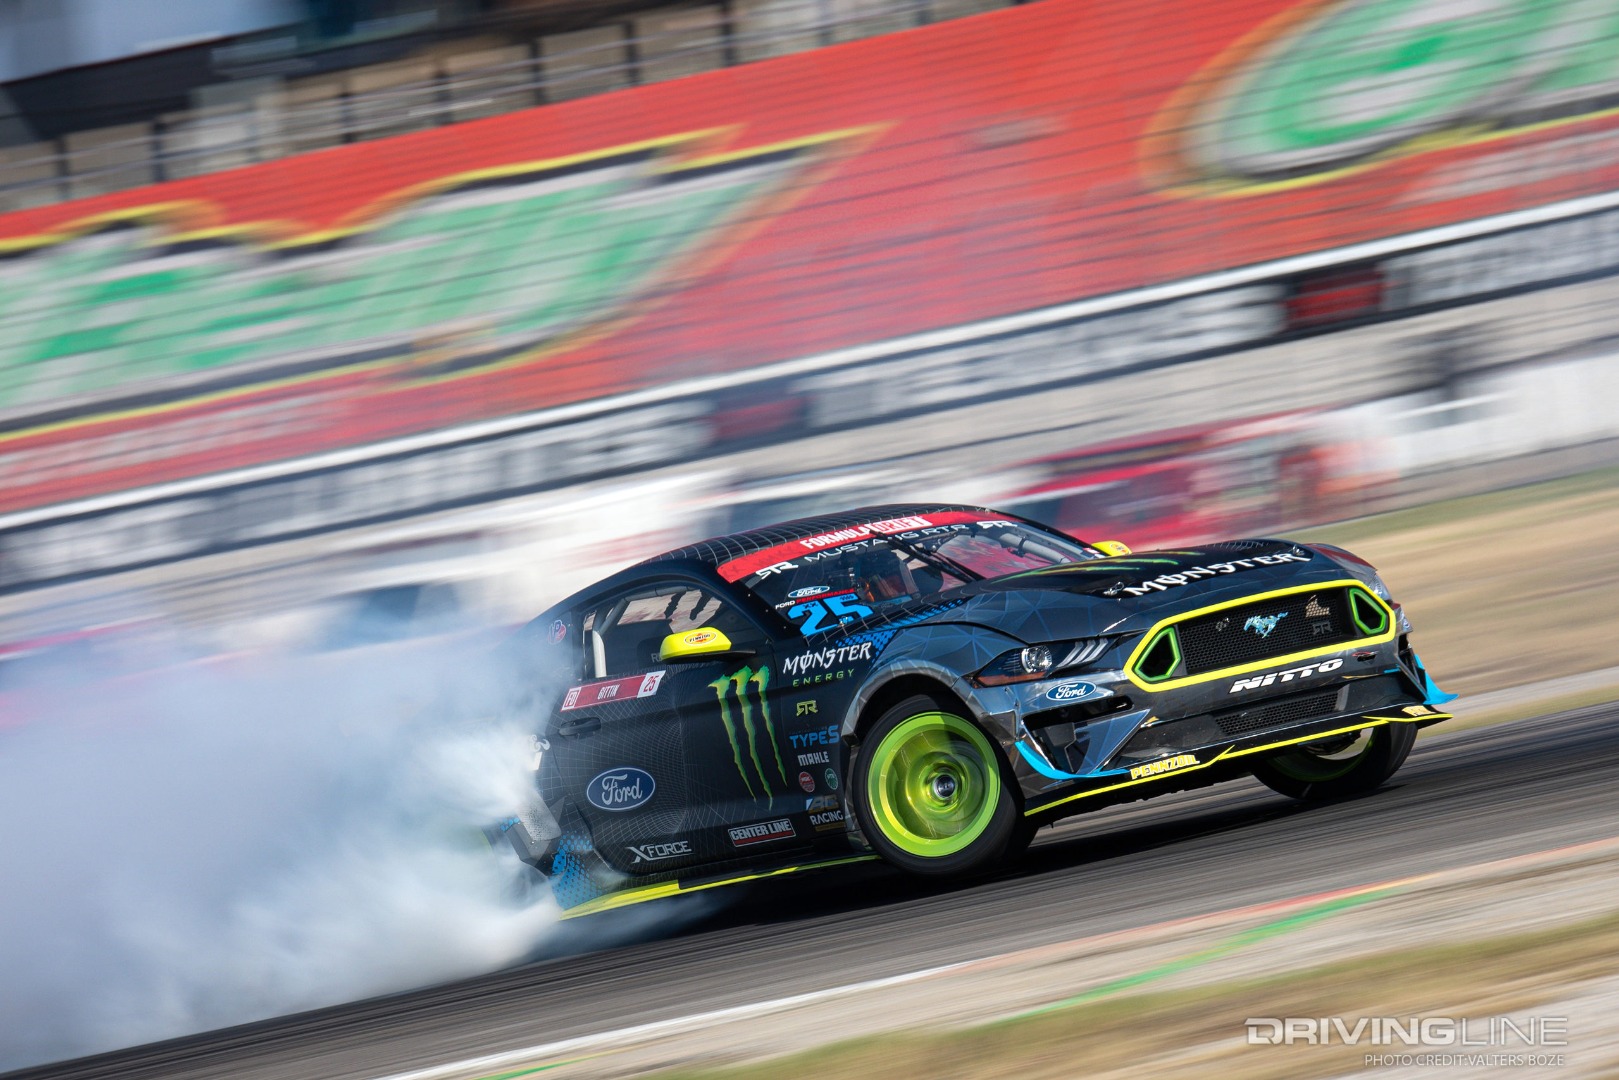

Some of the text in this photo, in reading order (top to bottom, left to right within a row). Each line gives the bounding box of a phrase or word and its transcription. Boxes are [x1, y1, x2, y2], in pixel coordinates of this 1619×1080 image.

[800, 515, 933, 549] FORMULA DRIFT
[1123, 551, 1312, 596] MONSTER
[775, 588, 855, 610] FORD PERFORMANCE
[797, 587, 822, 597] Ford
[787, 593, 874, 637] 25
[782, 641, 872, 675] MONSTER
[597, 684, 620, 700] GITTIN
[643, 675, 659, 692] 25
[792, 669, 854, 687] ENERGY
[1229, 658, 1344, 693] NITTO
[1055, 684, 1086, 699] Ford
[797, 751, 830, 766] MAHLE
[1130, 754, 1200, 780] PENNZOIL
[601, 773, 643, 805] Ford
[809, 810, 844, 825] RACING
[730, 820, 792, 841] CENTER LINE
